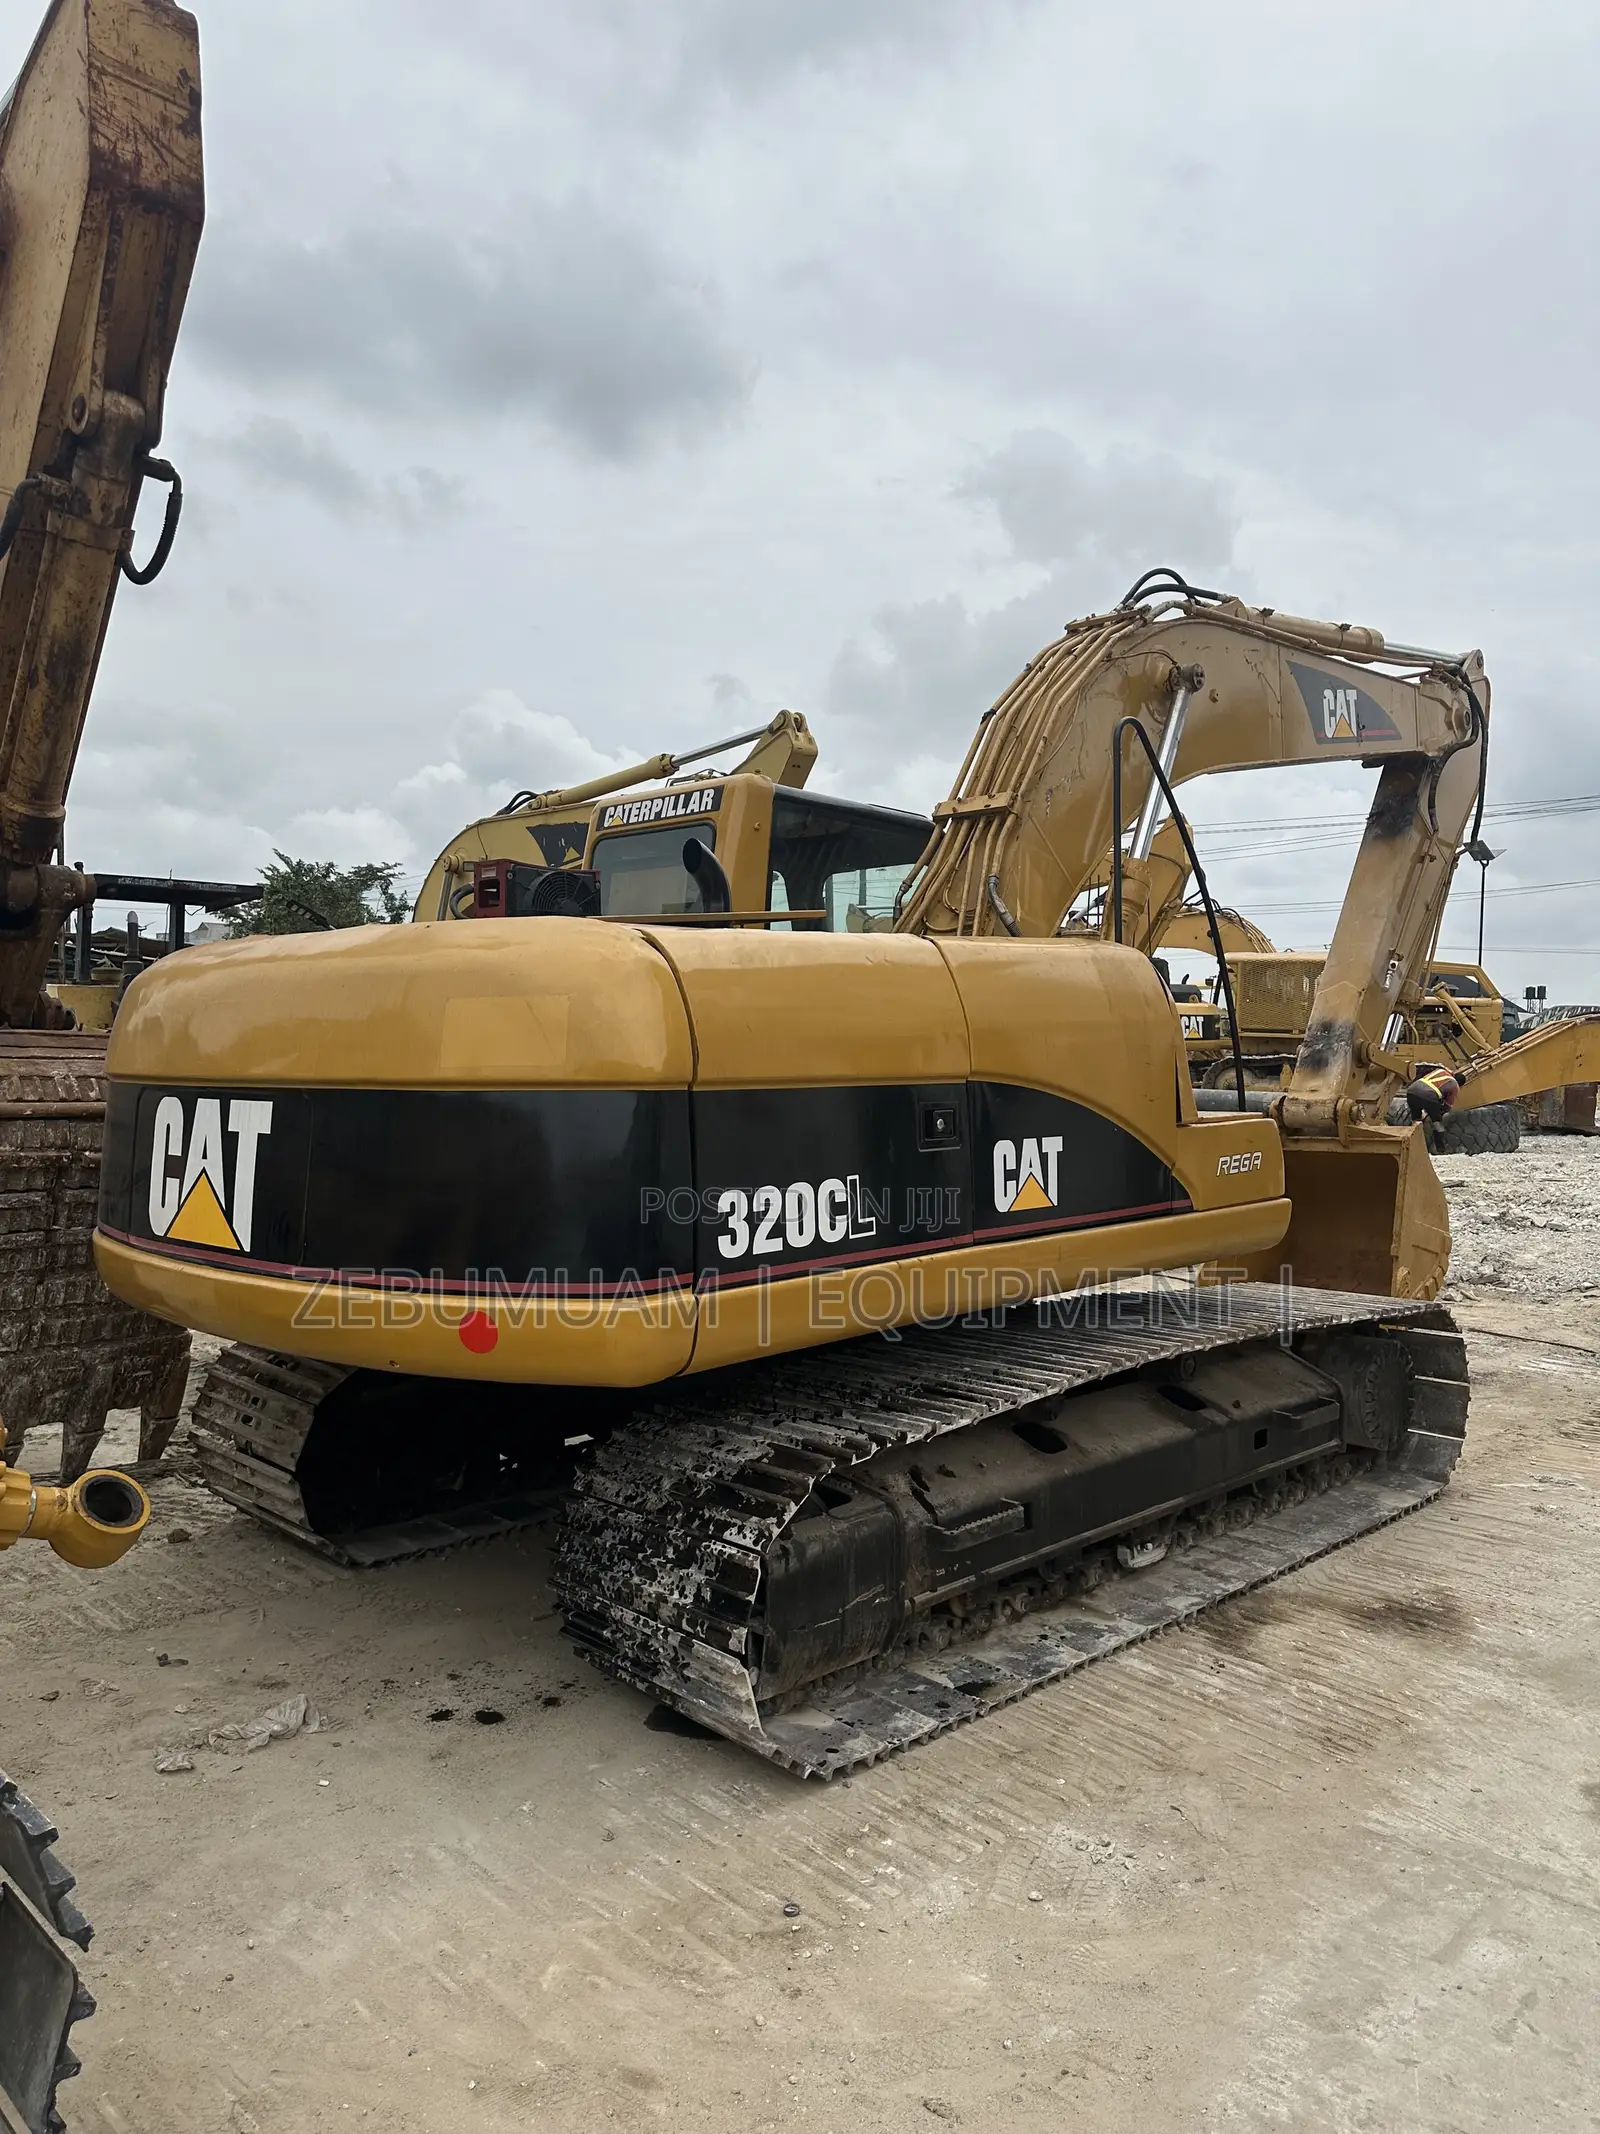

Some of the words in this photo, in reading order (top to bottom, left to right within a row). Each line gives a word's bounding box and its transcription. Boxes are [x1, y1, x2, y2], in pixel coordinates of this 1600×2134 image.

[1323, 688, 1357, 738] CAT
[604, 788, 715, 828] CATERPILLAR
[1181, 1015, 1204, 1039] CAT
[148, 1096, 273, 1252] CAT
[993, 1135, 1063, 1213] CAT
[1216, 1151, 1262, 1177] REGA
[717, 1174, 876, 1259] 320CL
